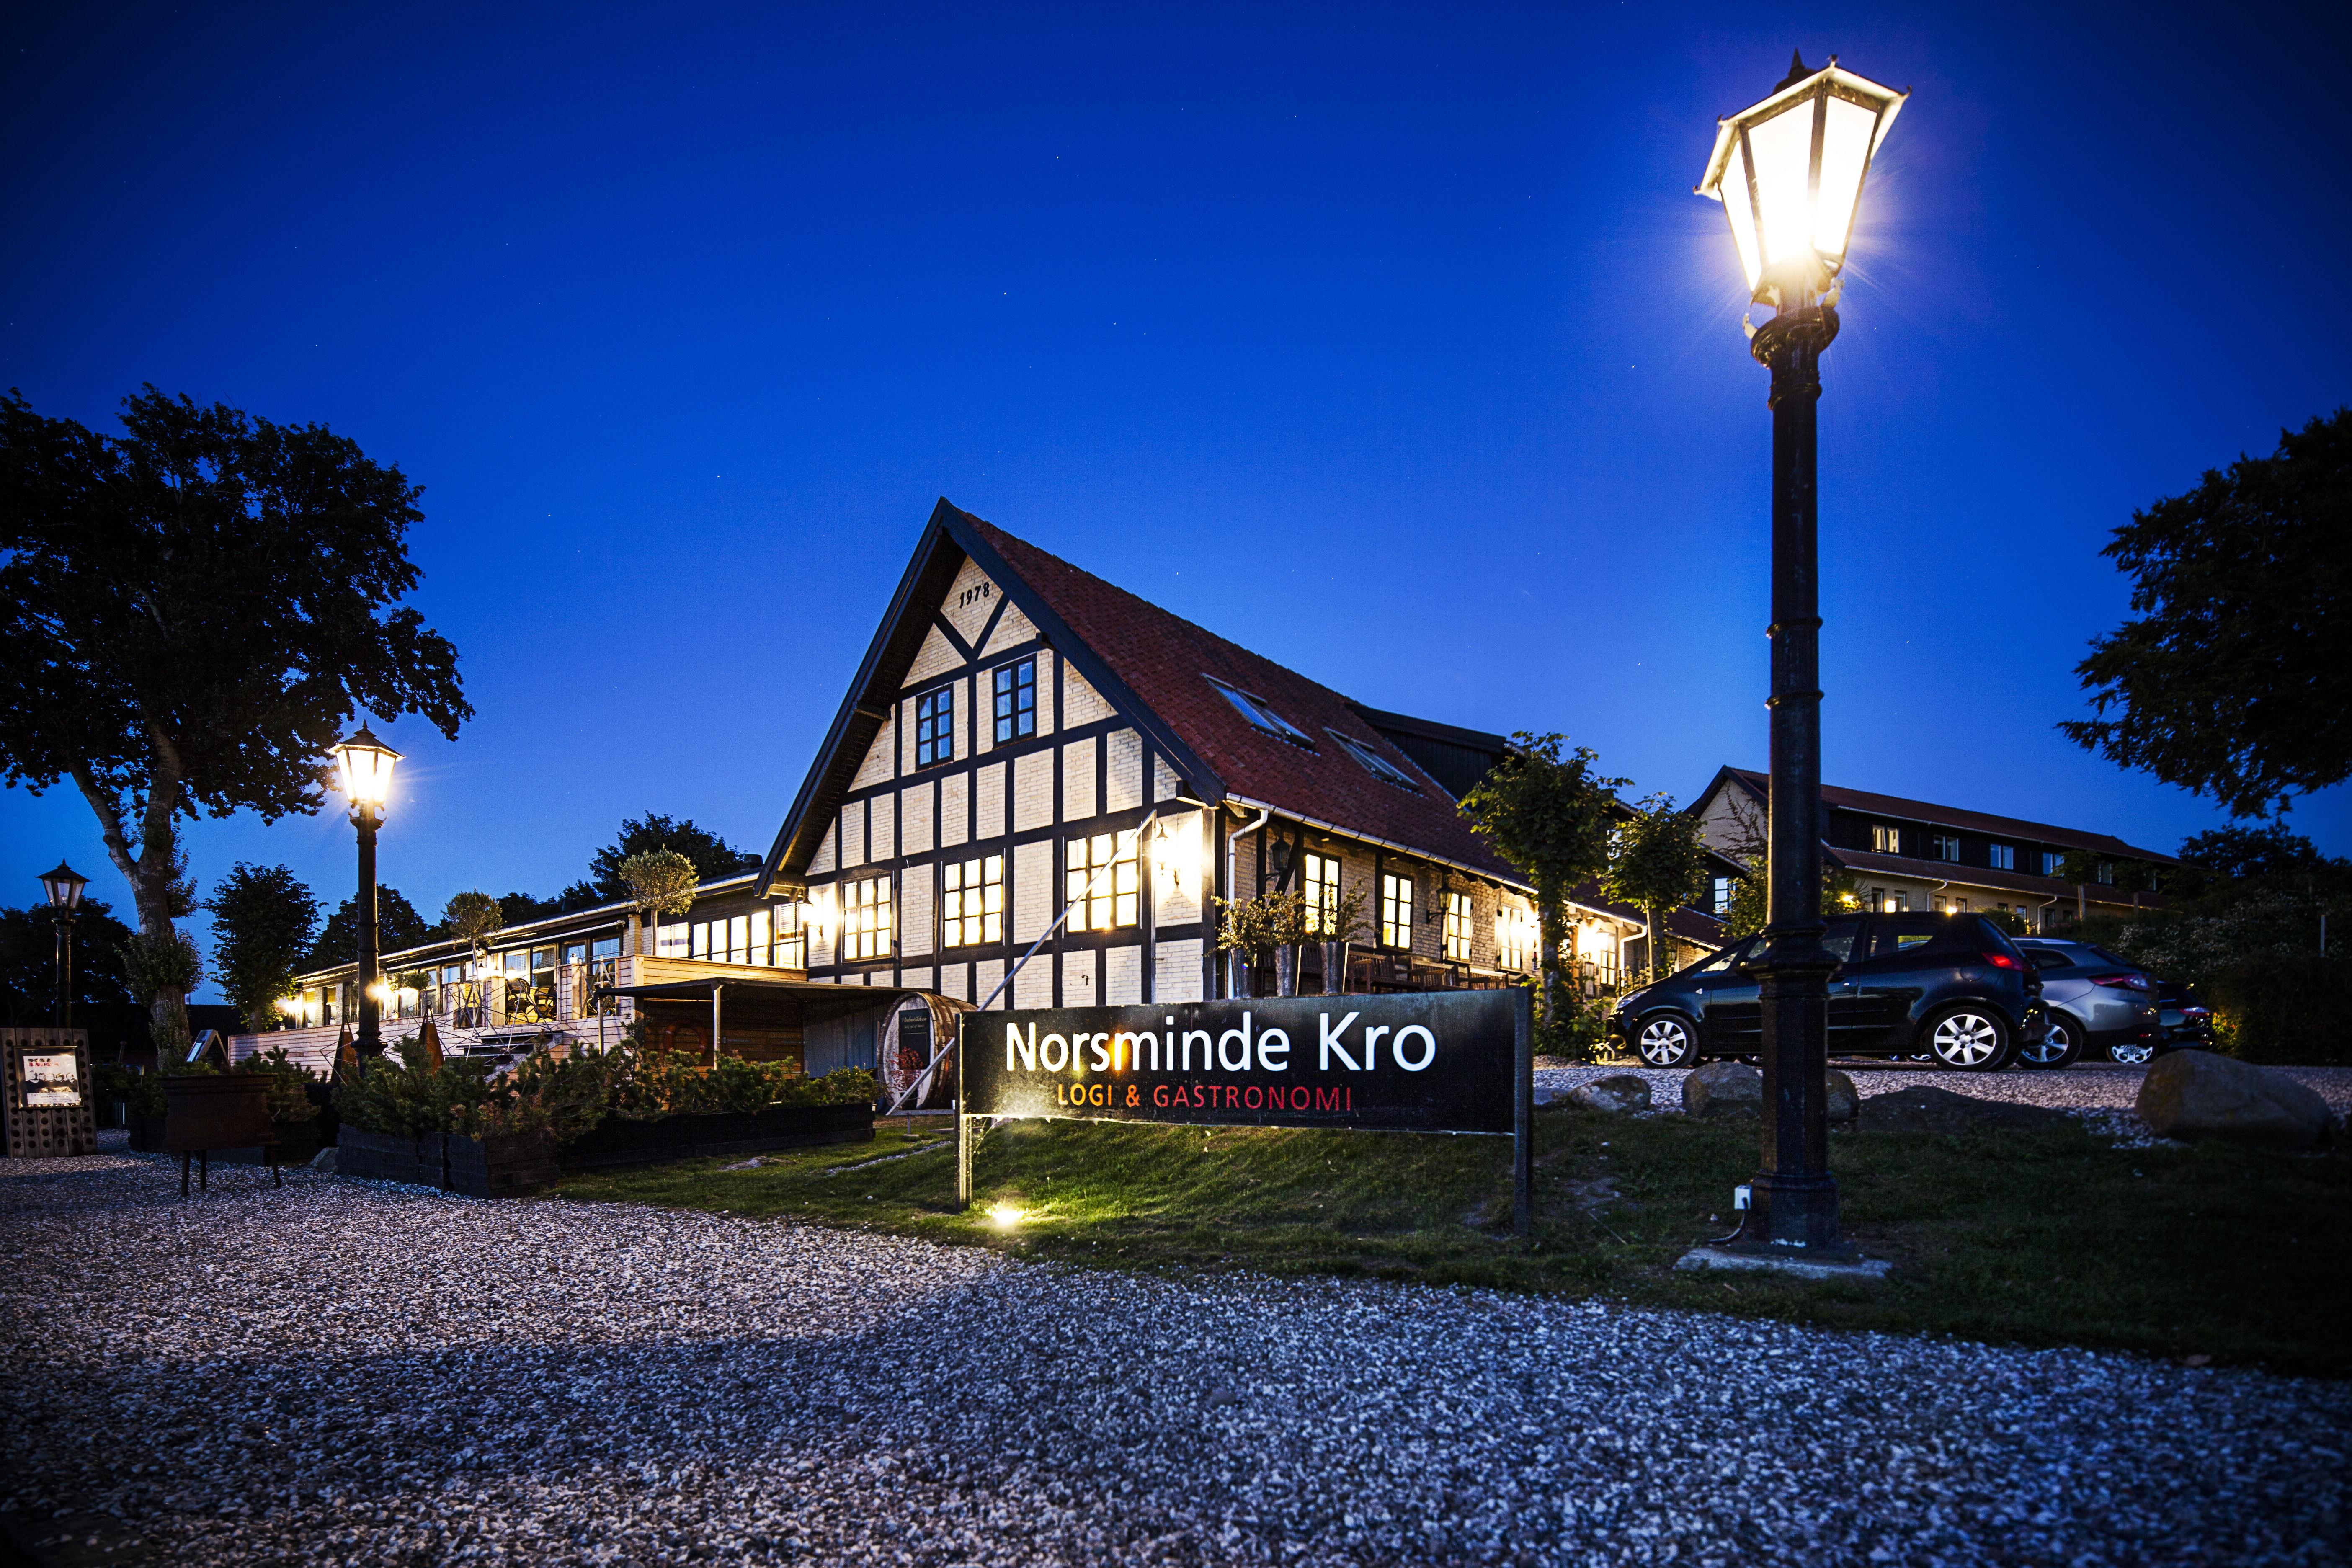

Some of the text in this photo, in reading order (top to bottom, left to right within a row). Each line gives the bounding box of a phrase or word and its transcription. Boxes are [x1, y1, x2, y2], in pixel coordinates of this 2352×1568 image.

[959, 582, 990, 609] 1978
[1006, 1011, 1436, 1072] Norsminde Kro
[1058, 1083, 1351, 1111] LOGI & GASTRONOMI
